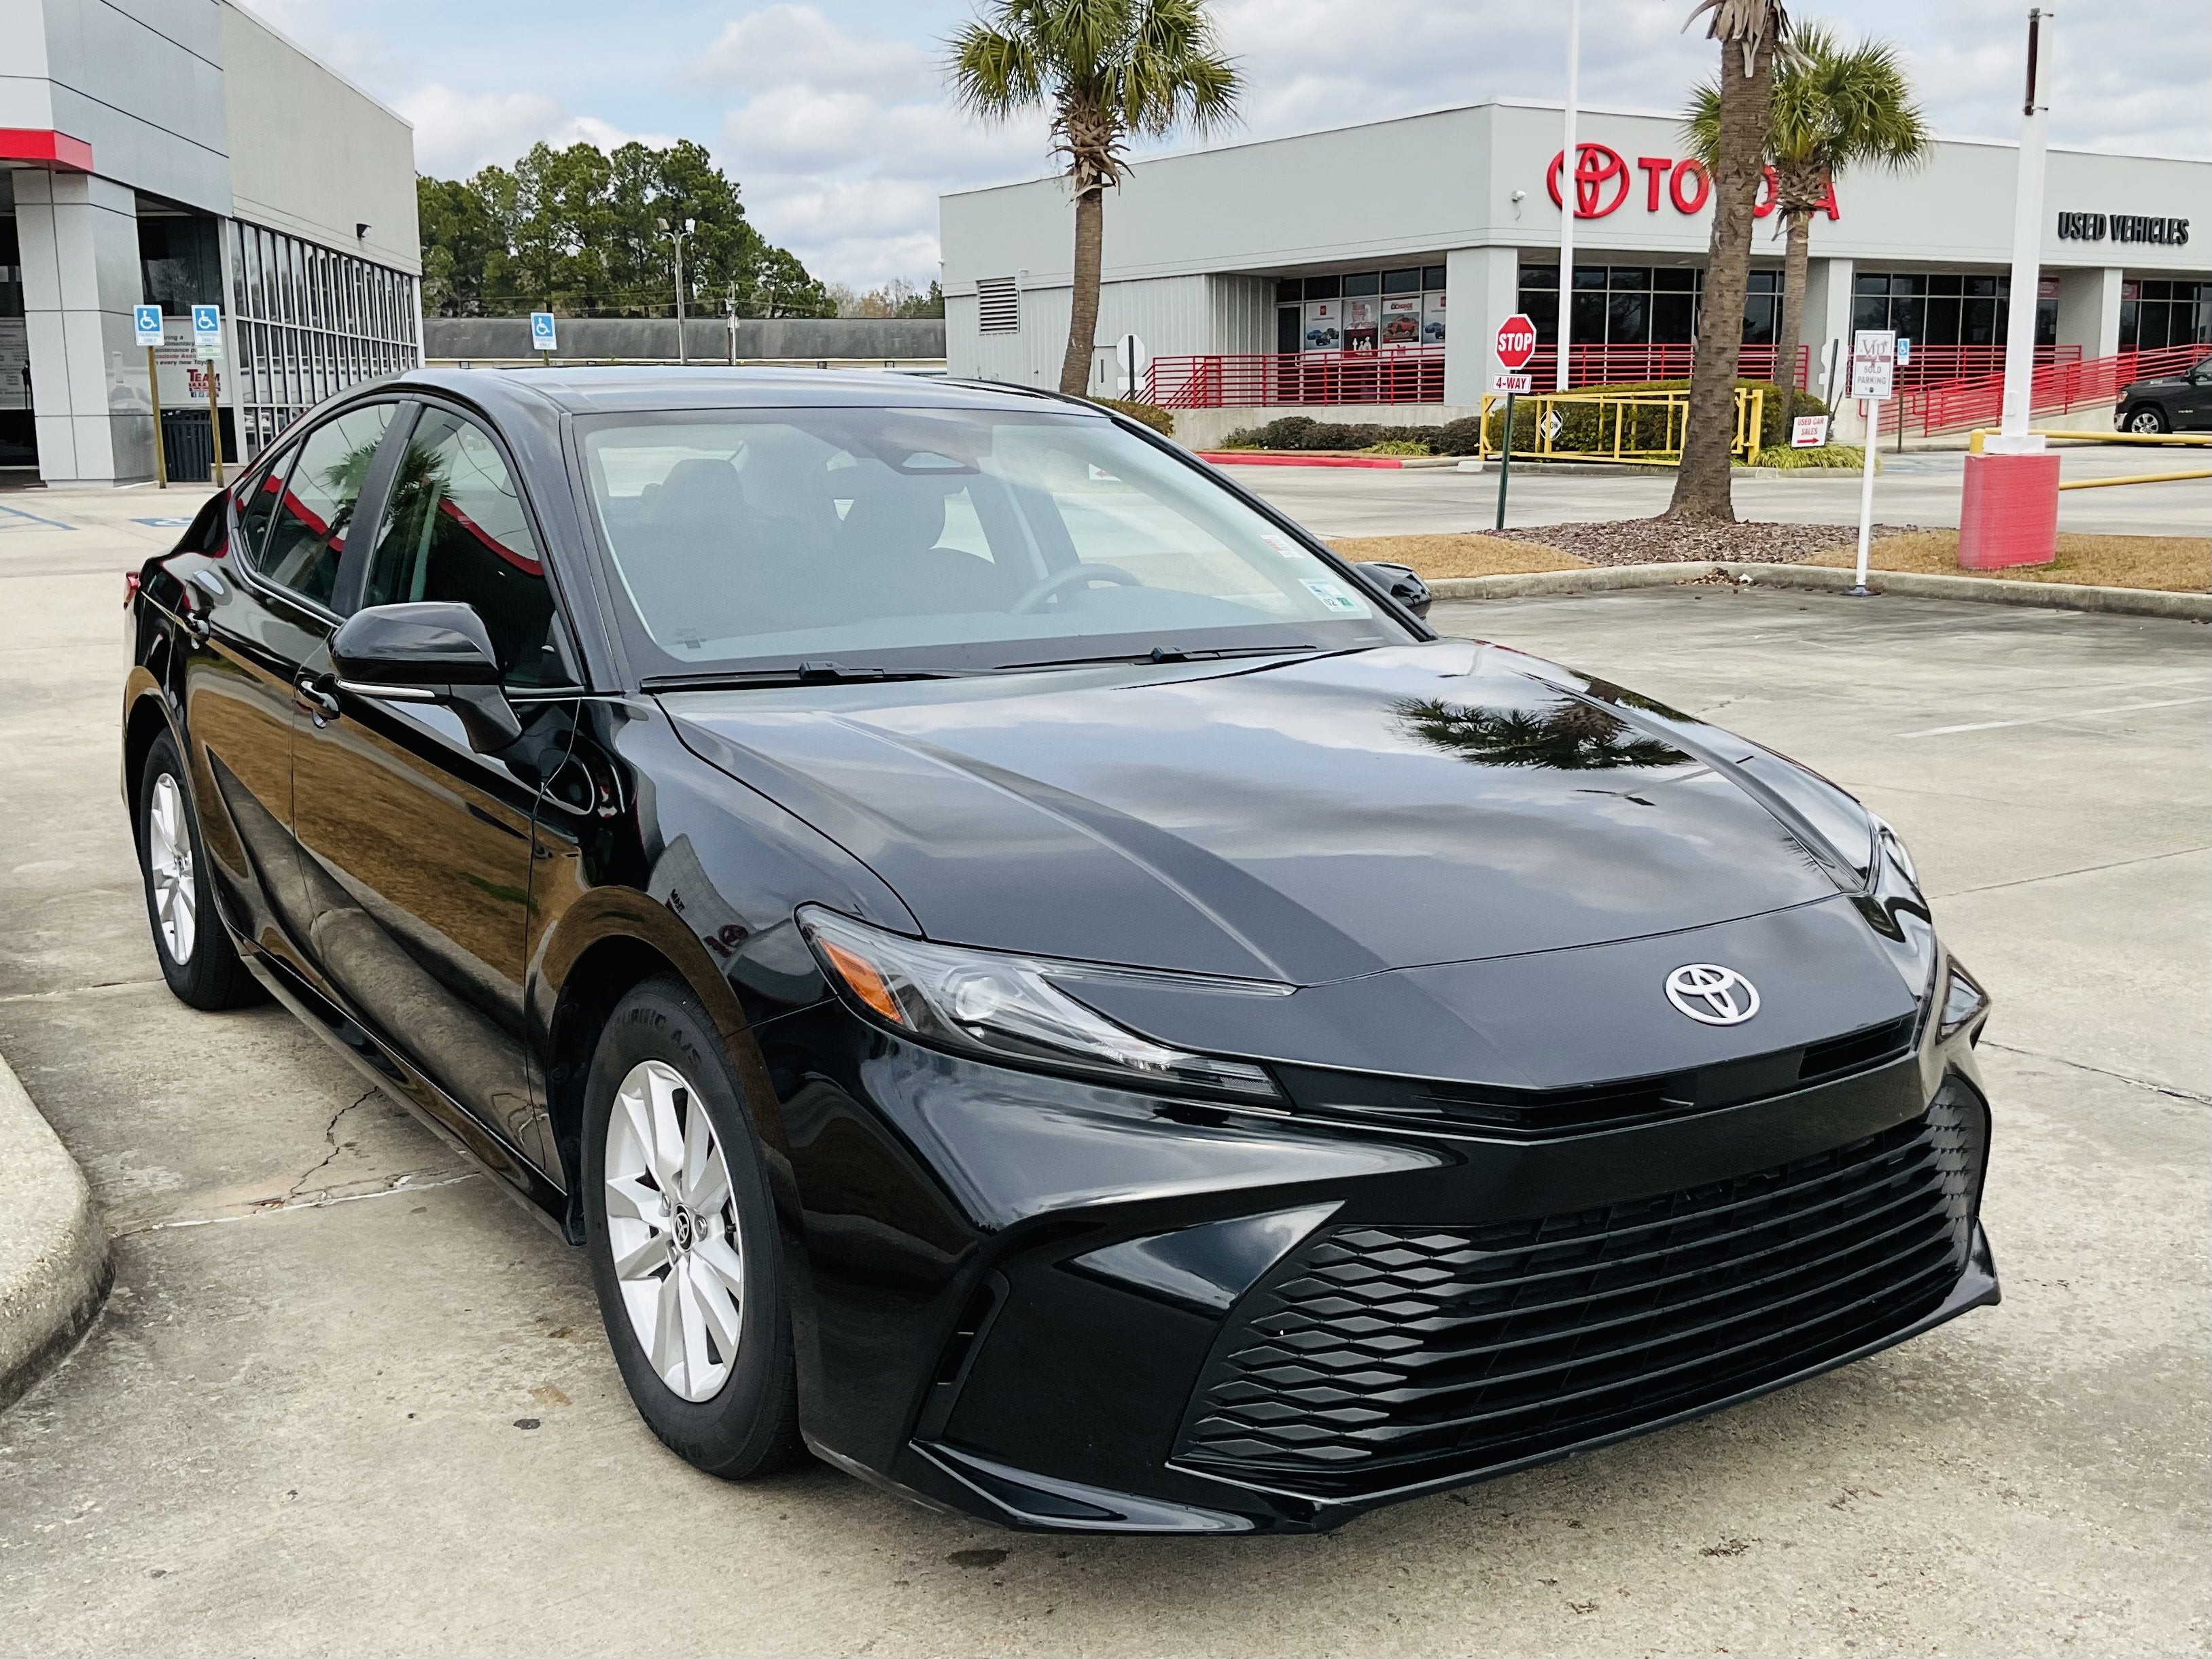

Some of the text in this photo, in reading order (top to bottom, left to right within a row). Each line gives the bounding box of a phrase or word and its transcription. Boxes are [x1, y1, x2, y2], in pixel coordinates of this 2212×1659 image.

[1637, 156, 1840, 221] TOA
[2058, 211, 2190, 245] USED VEHICLES
[1498, 332, 1532, 352] STOP
[1863, 366, 1882, 374] SOLD
[1496, 377, 1527, 390] 4-WAY
[1857, 376, 1886, 385] PARKING
[1543, 421, 1558, 430] SOW
[1797, 417, 1825, 426] USED CAR
[1801, 427, 1818, 436] SALES
